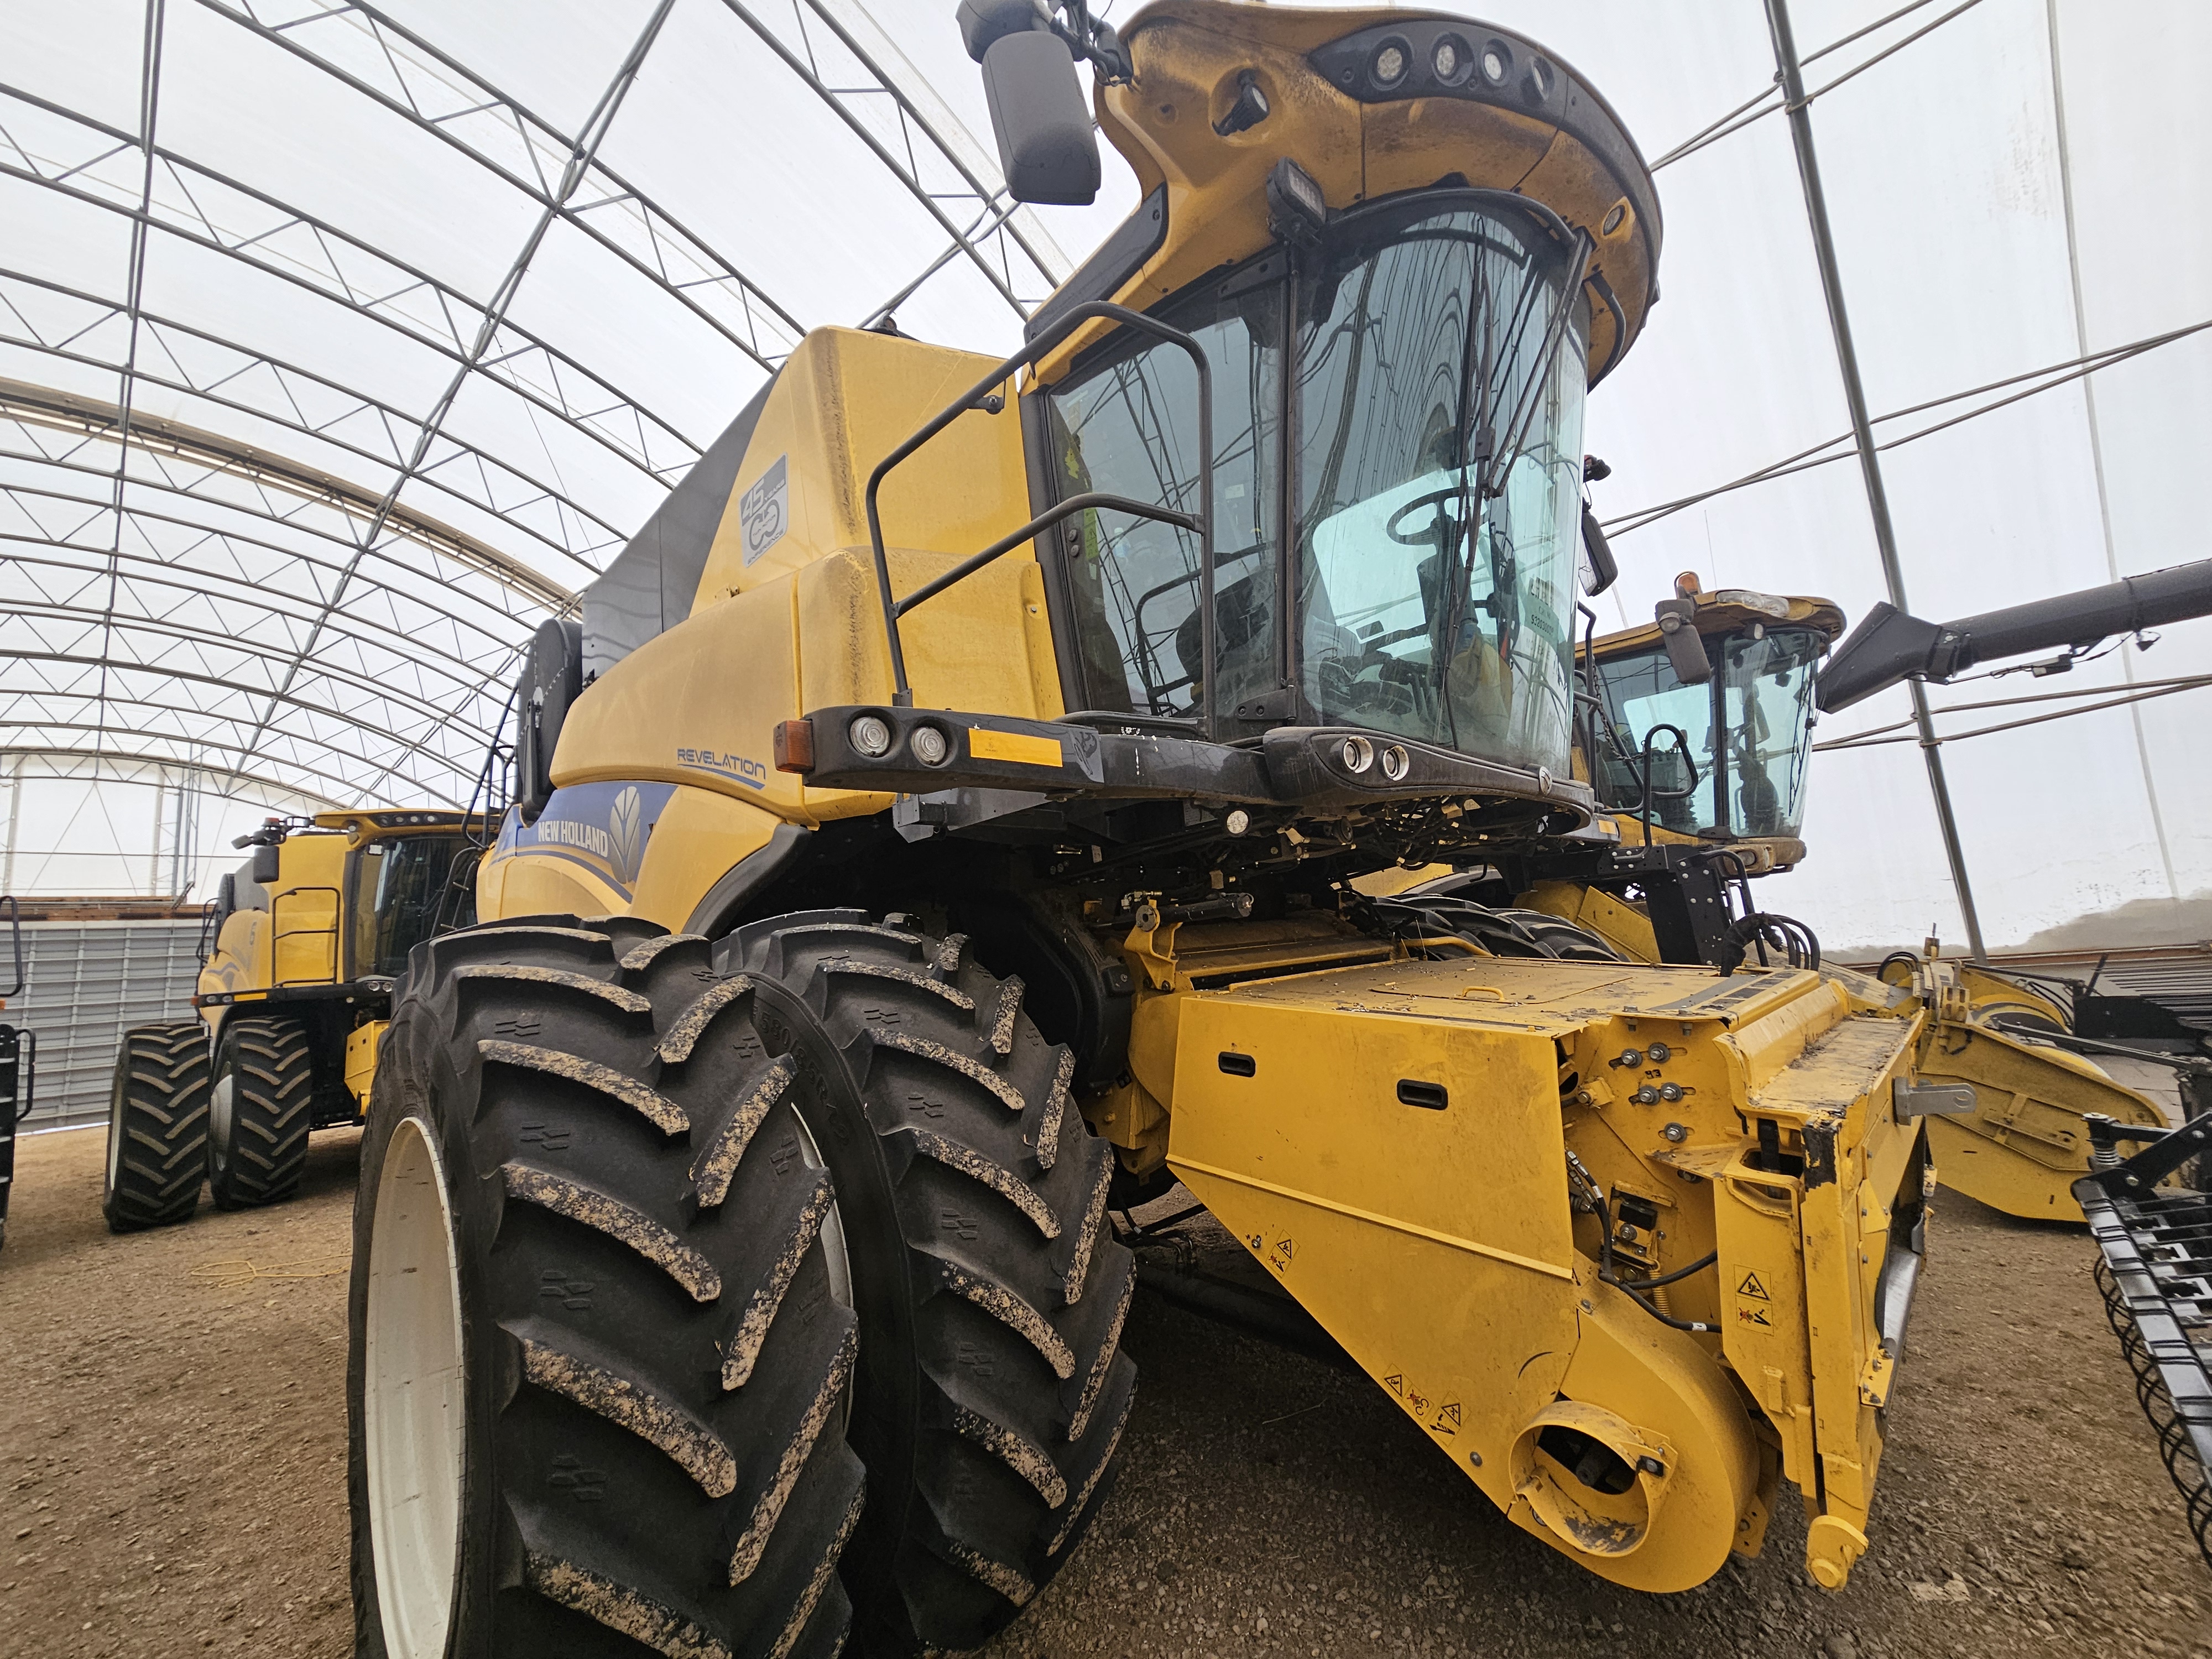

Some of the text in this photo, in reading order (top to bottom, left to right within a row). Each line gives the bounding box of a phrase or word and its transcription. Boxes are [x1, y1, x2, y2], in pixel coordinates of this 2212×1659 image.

[742, 478, 785, 519] 45 YEARS
[747, 528, 783, 565] EXPERIENCE
[677, 749, 766, 780] REVELATION
[538, 821, 608, 858] NEW HOLLAND
